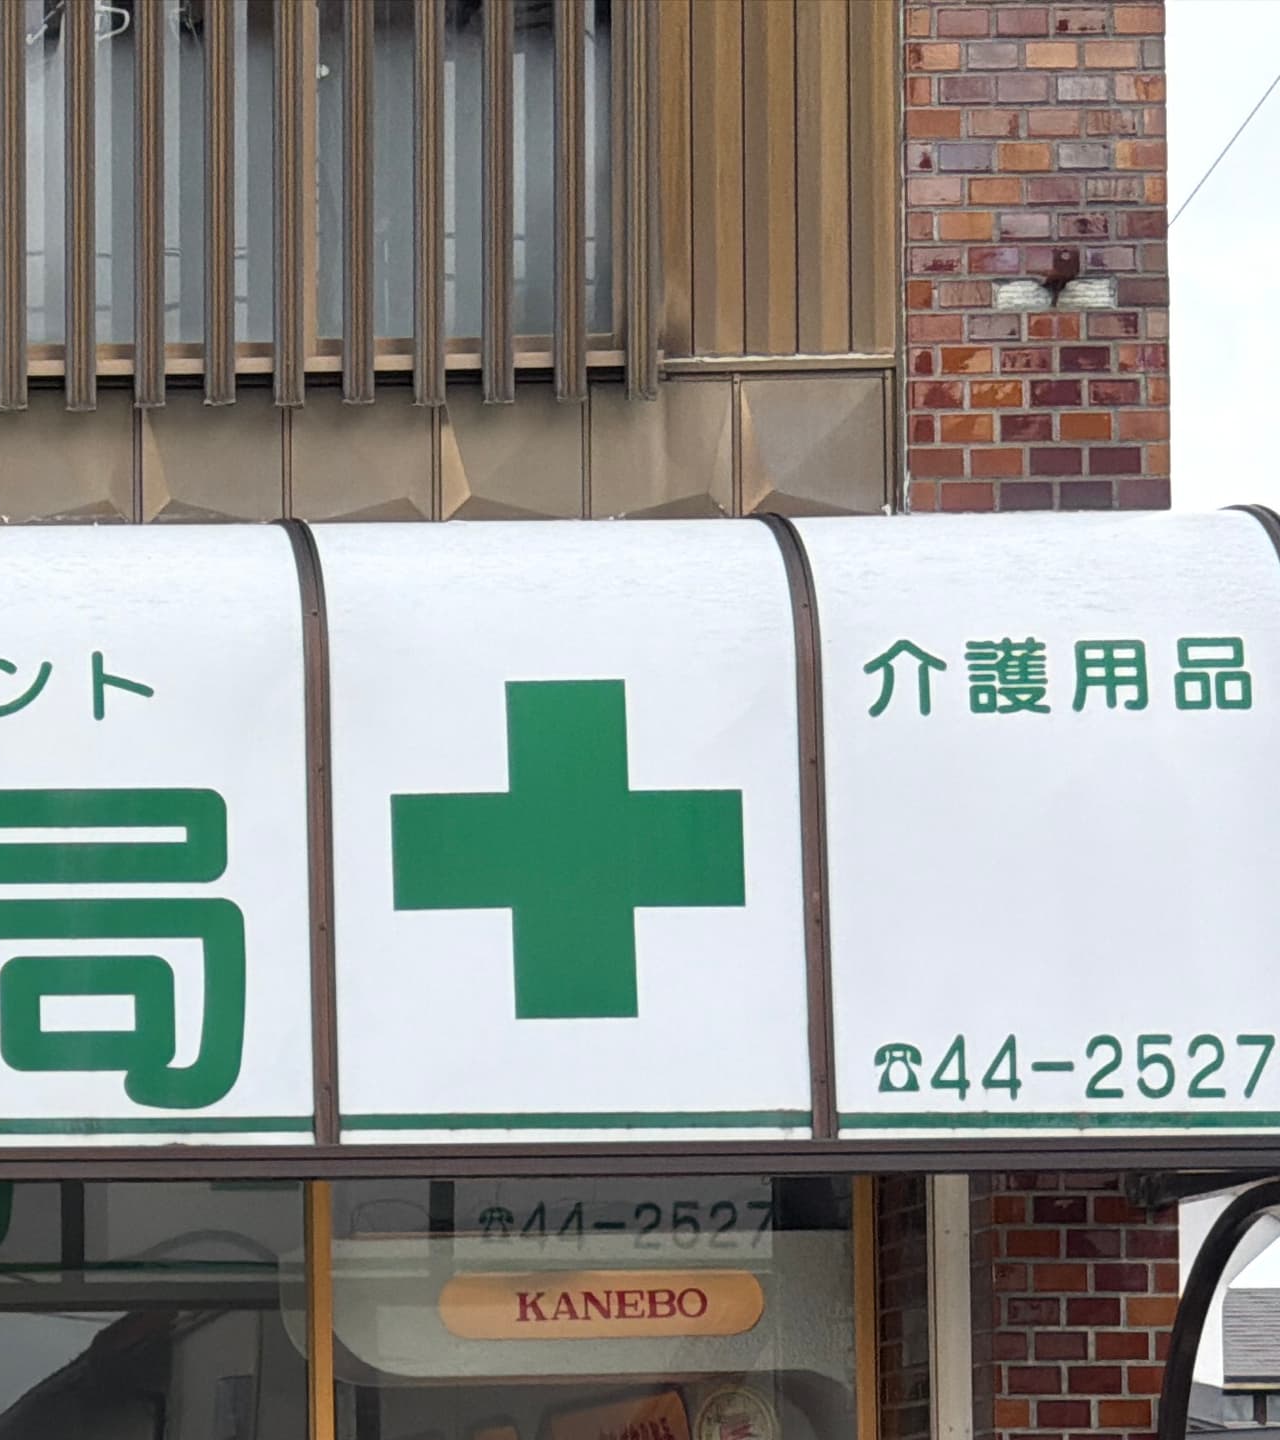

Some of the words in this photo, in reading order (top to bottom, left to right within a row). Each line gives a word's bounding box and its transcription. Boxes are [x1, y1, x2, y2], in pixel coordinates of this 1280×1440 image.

[863, 637, 1253, 717] 介護用品
[515, 1287, 708, 1323] KANEBO
